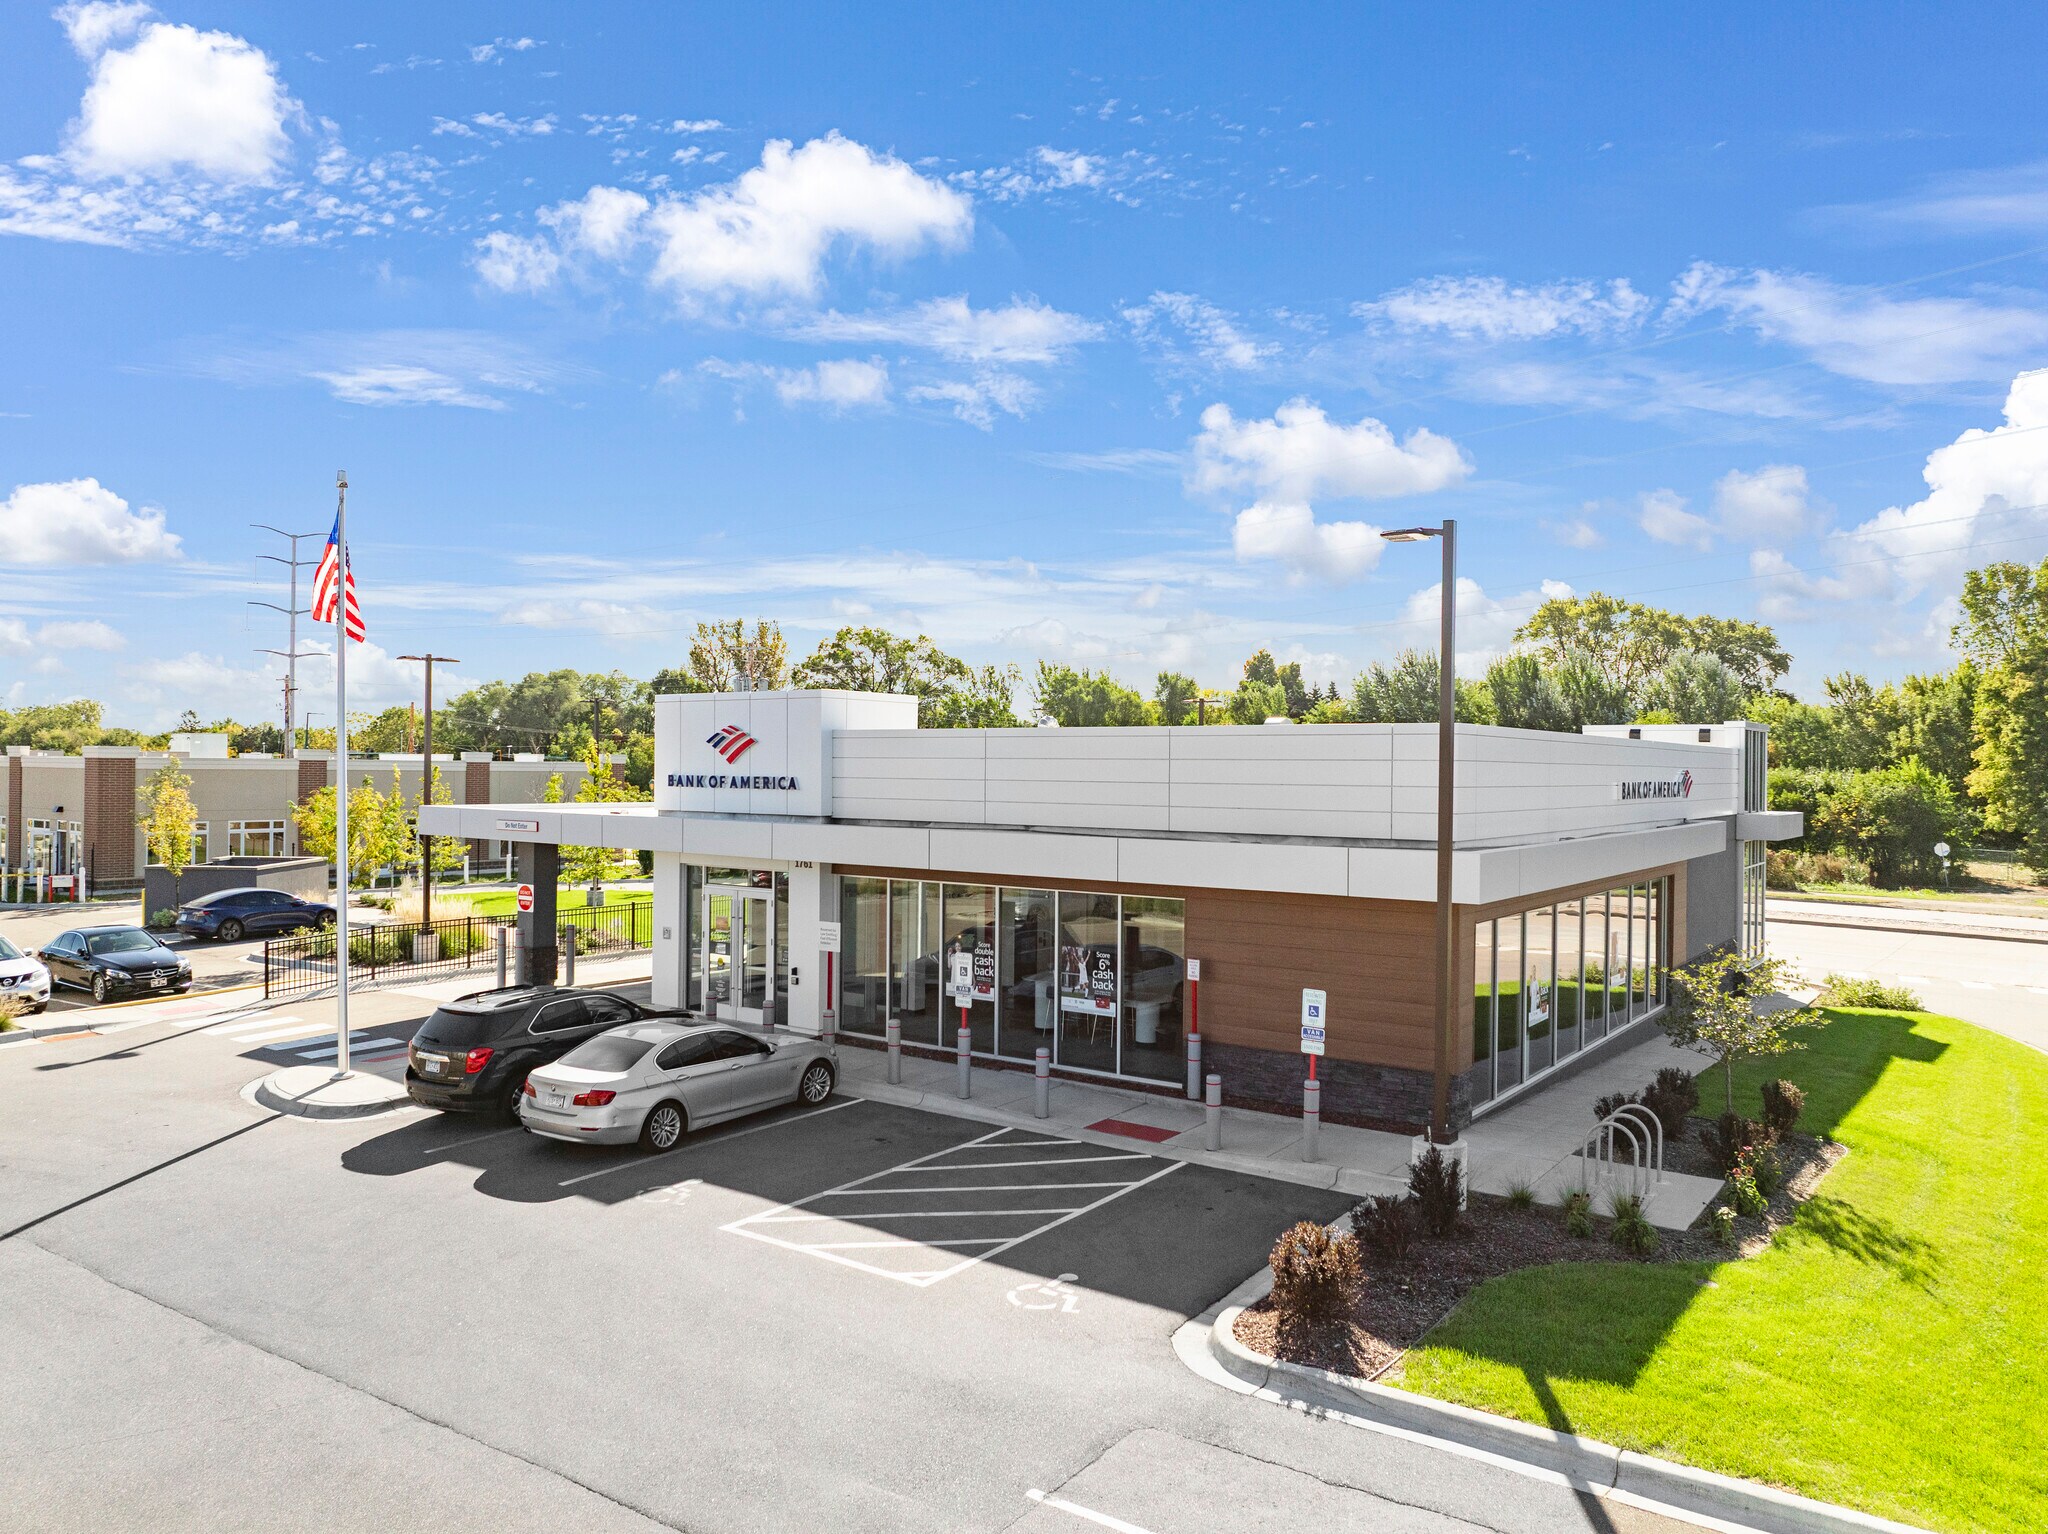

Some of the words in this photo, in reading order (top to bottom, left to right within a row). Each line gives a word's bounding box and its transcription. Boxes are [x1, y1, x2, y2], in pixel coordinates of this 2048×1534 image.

[668, 775, 704, 788] BANK
[708, 775, 726, 789] OF
[729, 776, 797, 790] AMERICA
[1621, 782, 1641, 800] BANK
[1643, 781, 1652, 799] OF
[1652, 781, 1681, 798] AMERICA
[1096, 951, 1111, 959] Score
[974, 956, 994, 966] cash
[974, 965, 994, 977] back
[1092, 969, 1114, 980] cash
[1092, 978, 1114, 991] back
[1306, 1029, 1321, 1037] VAN
